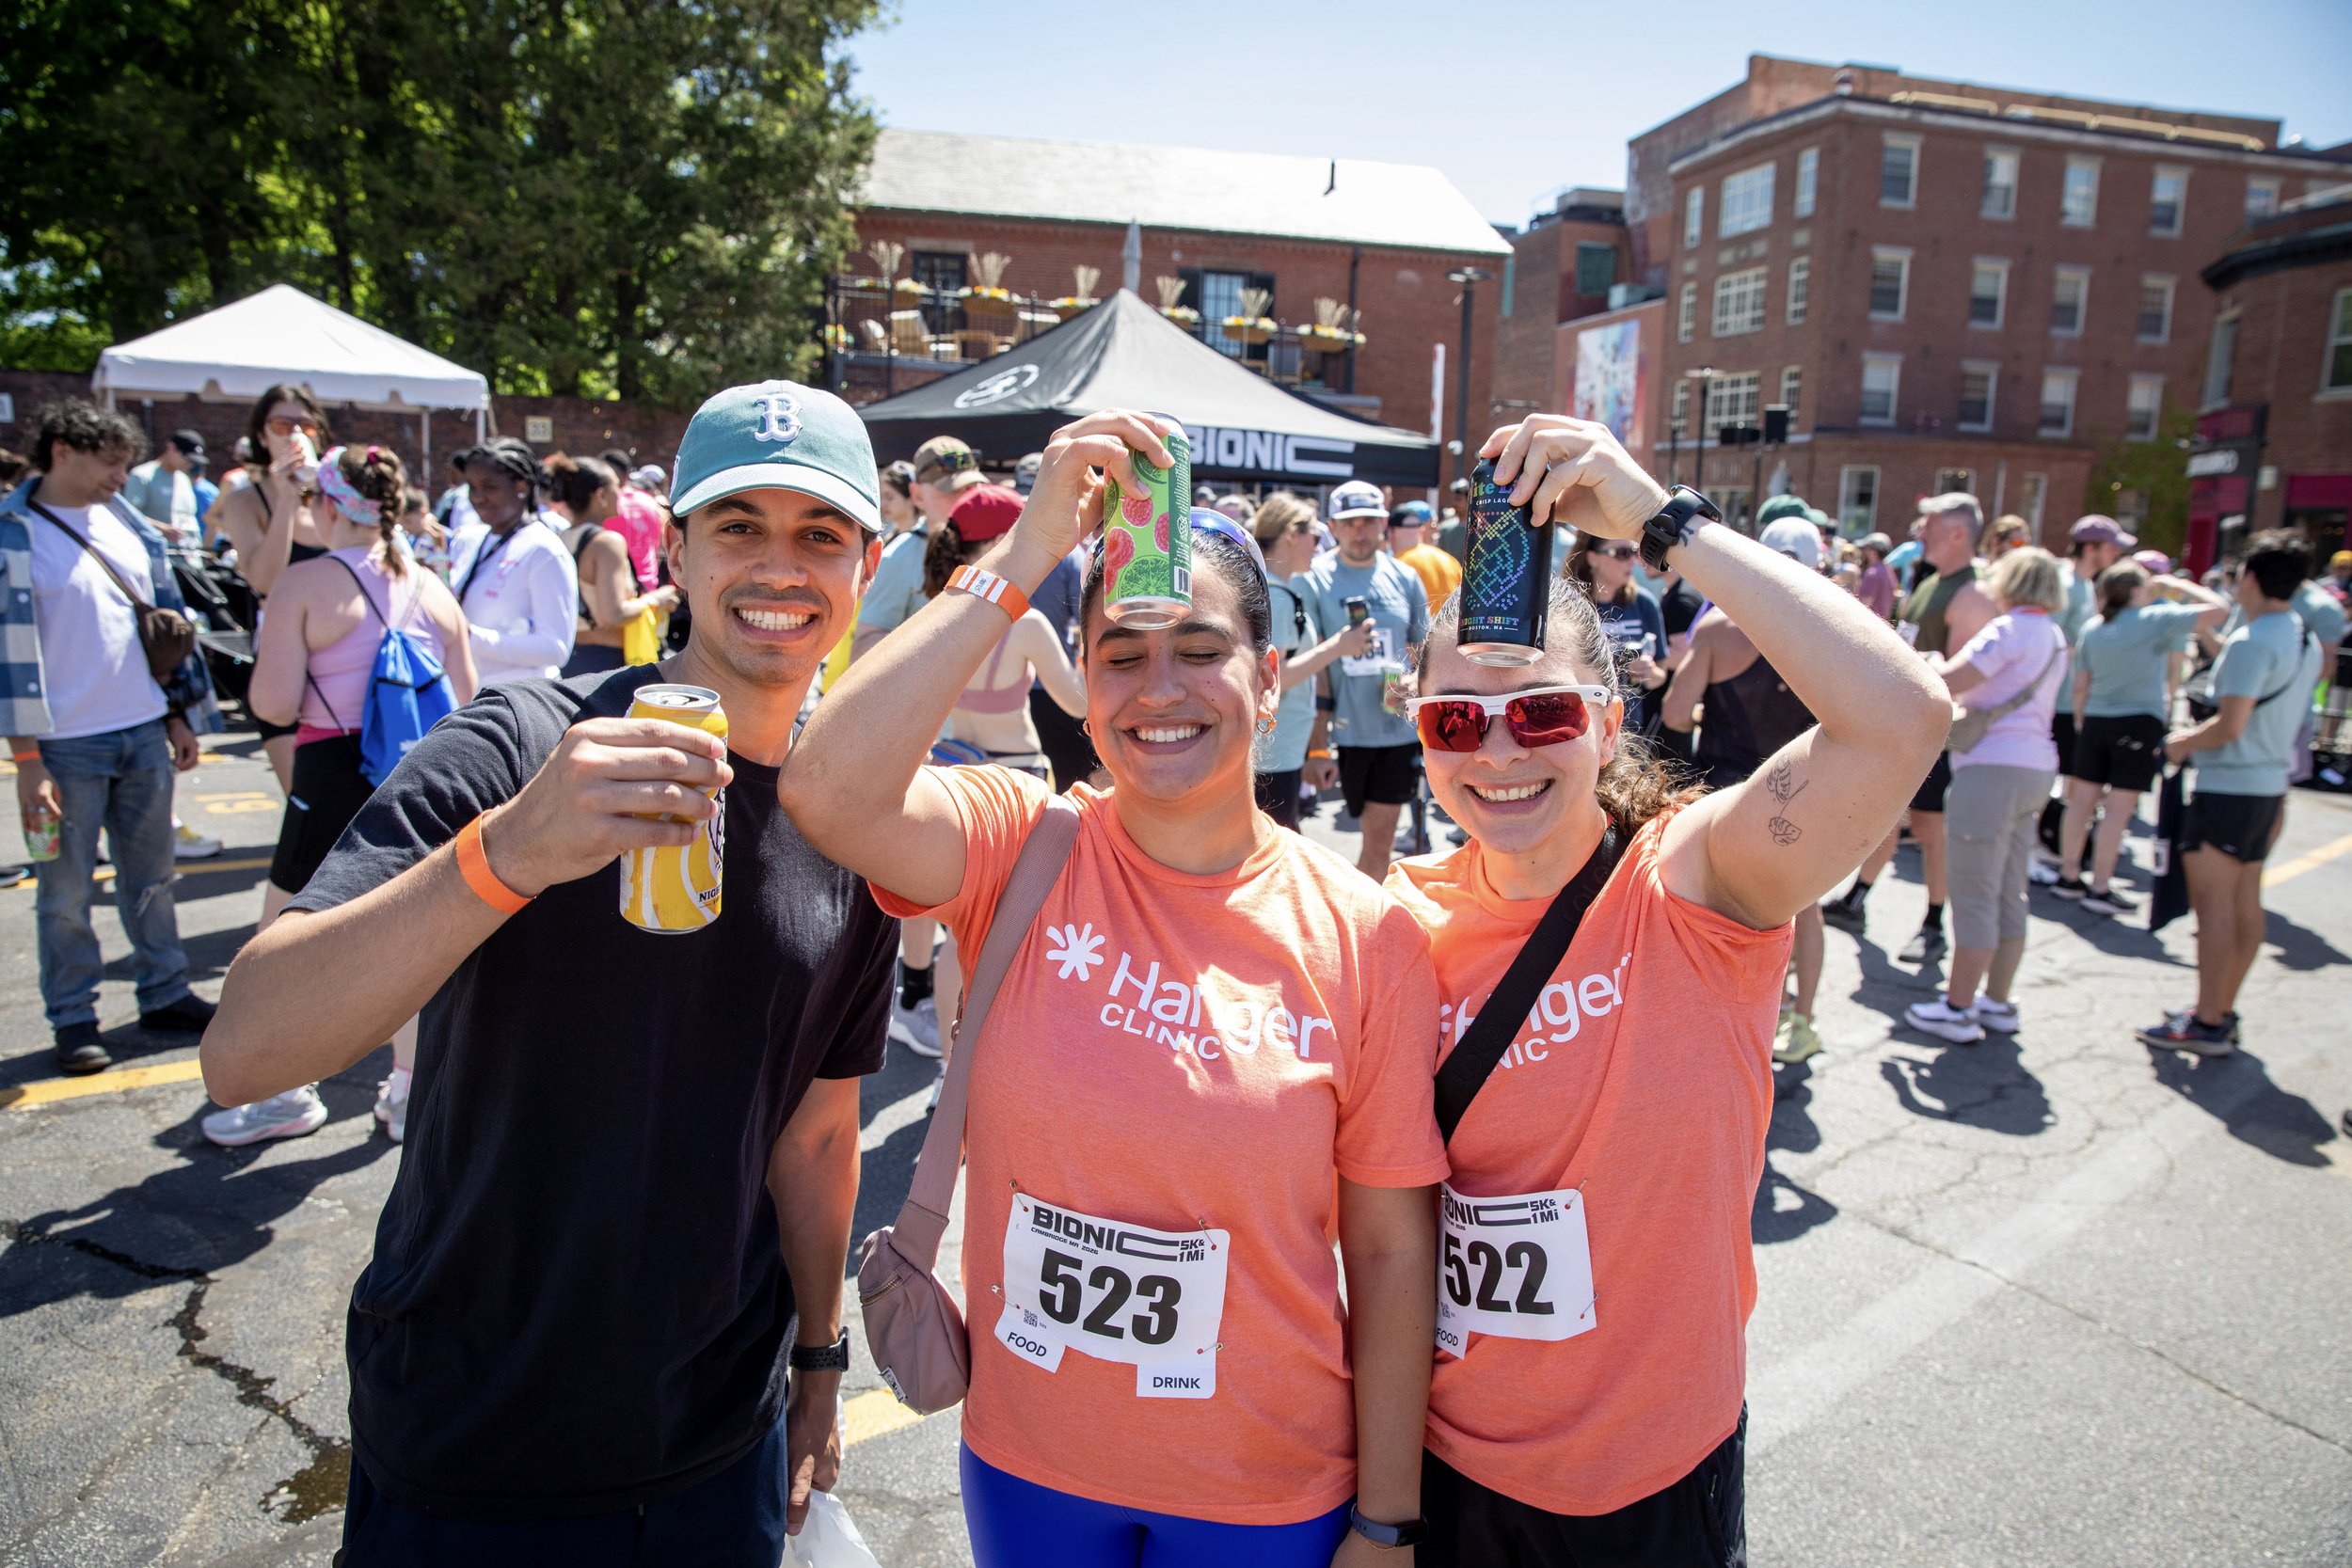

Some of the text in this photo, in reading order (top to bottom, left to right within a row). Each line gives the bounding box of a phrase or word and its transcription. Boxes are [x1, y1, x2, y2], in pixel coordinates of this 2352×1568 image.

[753, 393, 803, 442] B
[1182, 424, 1356, 477] BIONIC
[1471, 482, 1496, 498] ite
[1486, 616, 1519, 626] SHIFT
[699, 884, 722, 902] NIG
[1100, 1003, 1220, 1060] CLINIC
[1530, 1198, 1557, 1212] 5K&
[1030, 1227, 1069, 1244] CAMBRIDGE
[1069, 1240, 1079, 1248] MA
[1032, 1205, 1179, 1261] BIONIC
[1180, 1239, 1205, 1250] 5K&
[1444, 1230, 1555, 1314] 522
[1039, 1247, 1182, 1345] 523
[1007, 1331, 1047, 1357] FOOD
[1436, 1327, 1459, 1347] FOOD
[1152, 1376, 1201, 1389] DRINK
